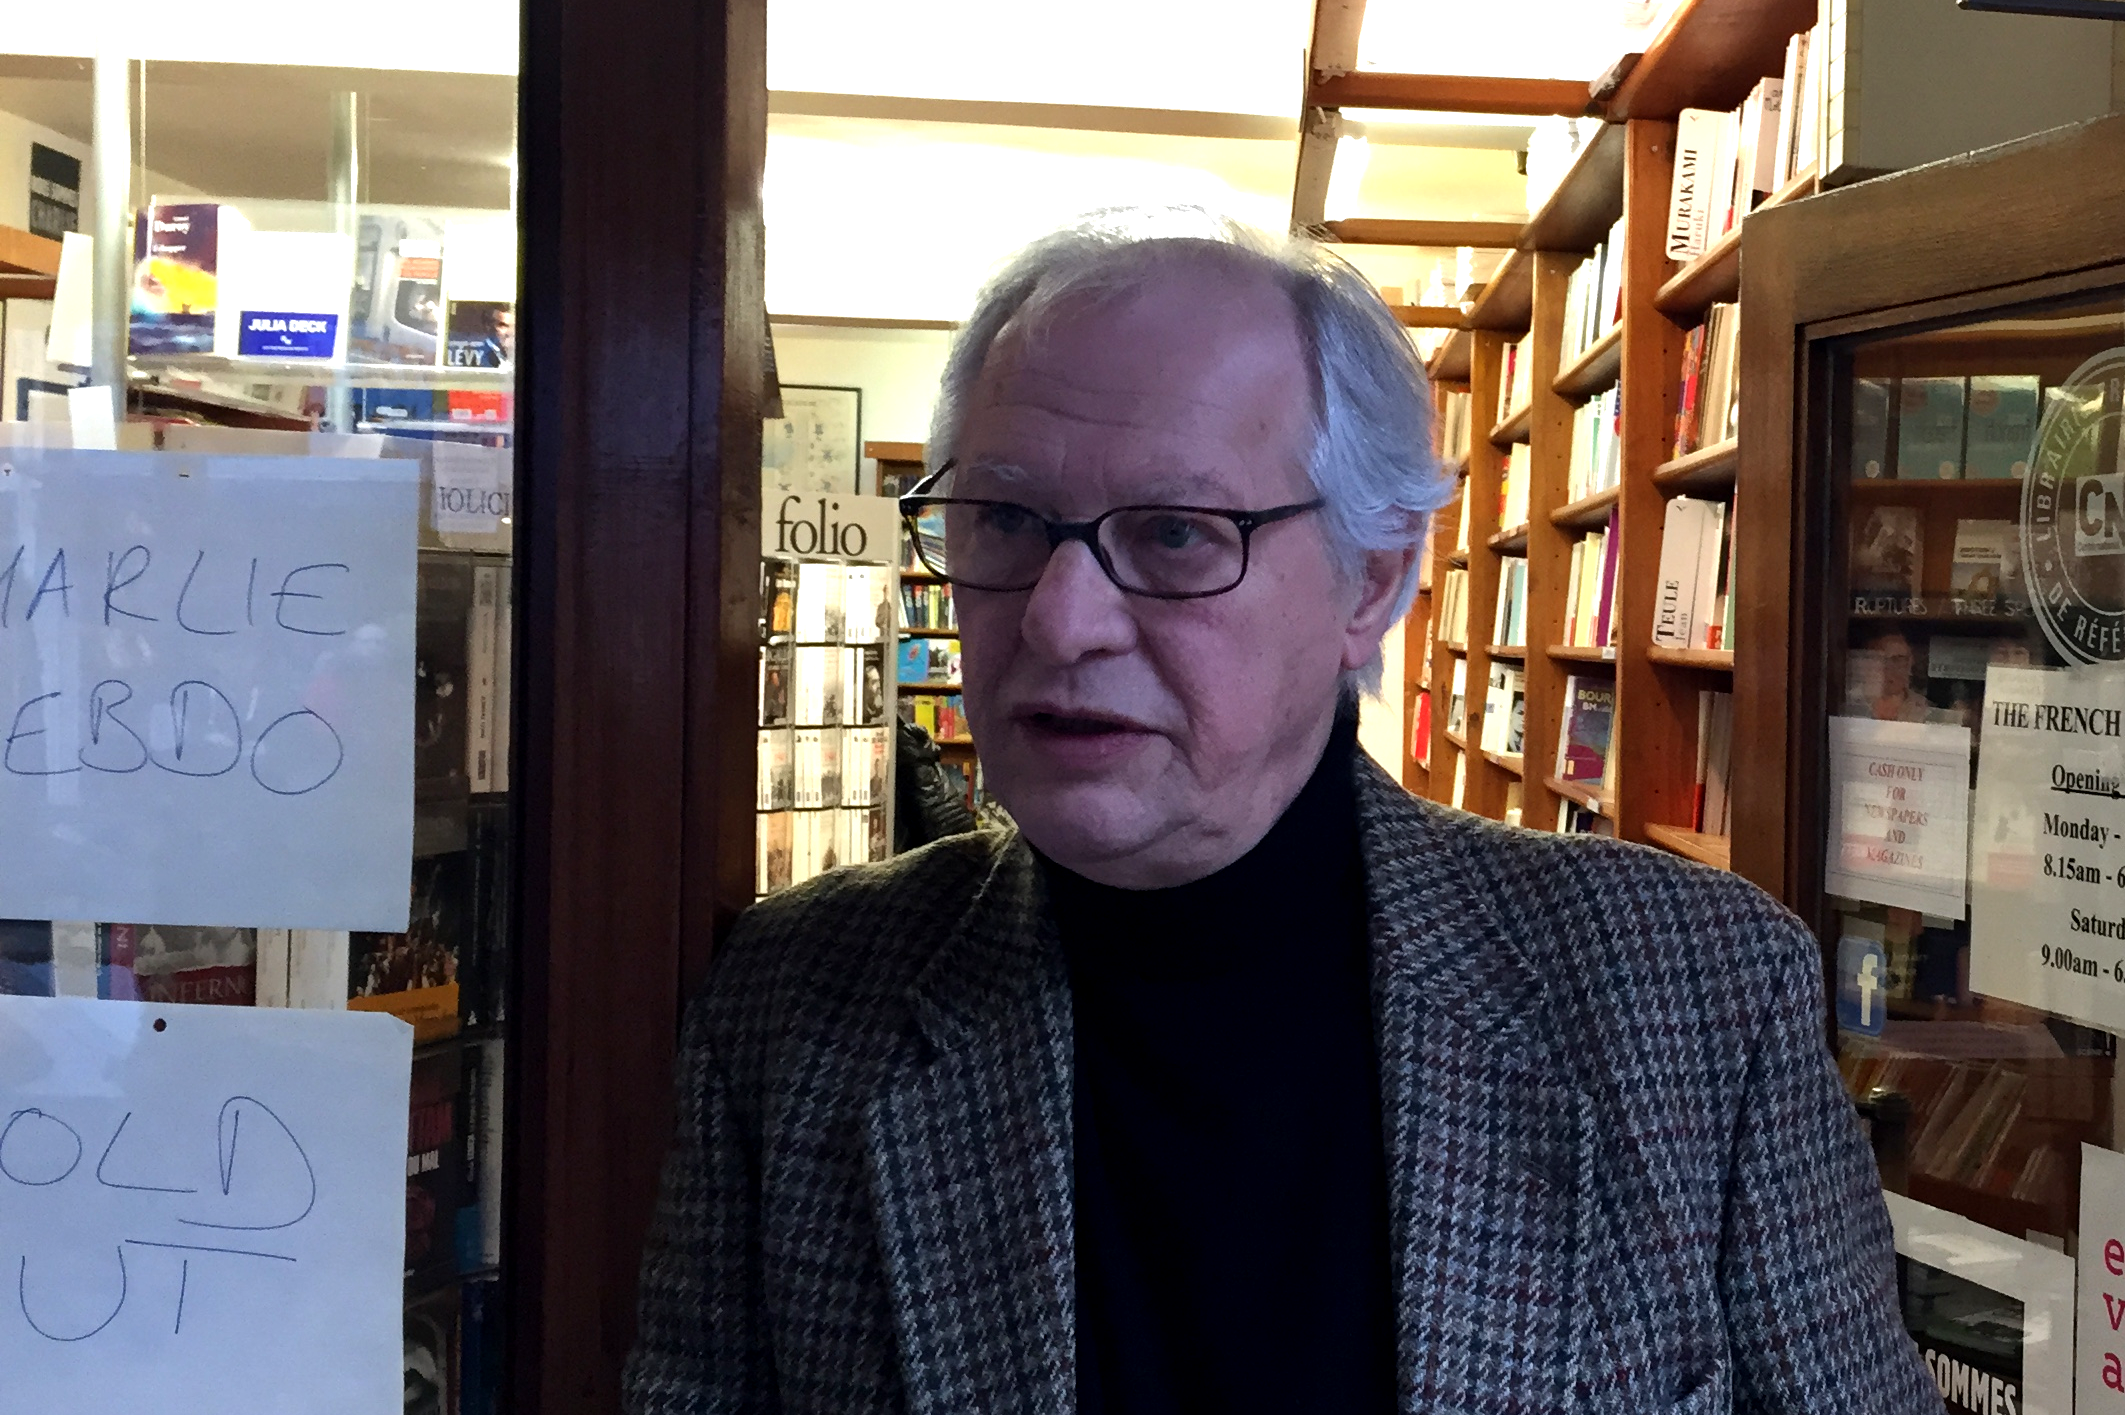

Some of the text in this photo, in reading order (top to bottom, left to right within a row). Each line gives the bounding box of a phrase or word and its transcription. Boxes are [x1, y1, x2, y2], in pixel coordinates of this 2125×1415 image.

[1669, 148, 1698, 252] MURAKAMI
[248, 318, 327, 333] JULIA DECK
[775, 495, 868, 557] folio
[1656, 580, 1679, 641] TEULE
[2048, 581, 2125, 654] DE RÉFÉ
[1577, 689, 1614, 704] BOUR
[1992, 700, 2122, 737] THE FRENCH
[1868, 761, 1924, 781] CASH ONLY
[2051, 764, 2120, 799] Opening
[1886, 785, 1906, 800] FOR
[1864, 803, 1929, 826] NEWSPAPERS
[2043, 812, 2110, 849] Monday
[1886, 829, 1906, 844] AND
[1866, 846, 1924, 869] MAGAZINES
[2043, 853, 2101, 884] 8.15am
[2041, 943, 2099, 977] 9.00am
[0, 1096, 316, 1231] OLD
[19, 1239, 297, 1342] UT
